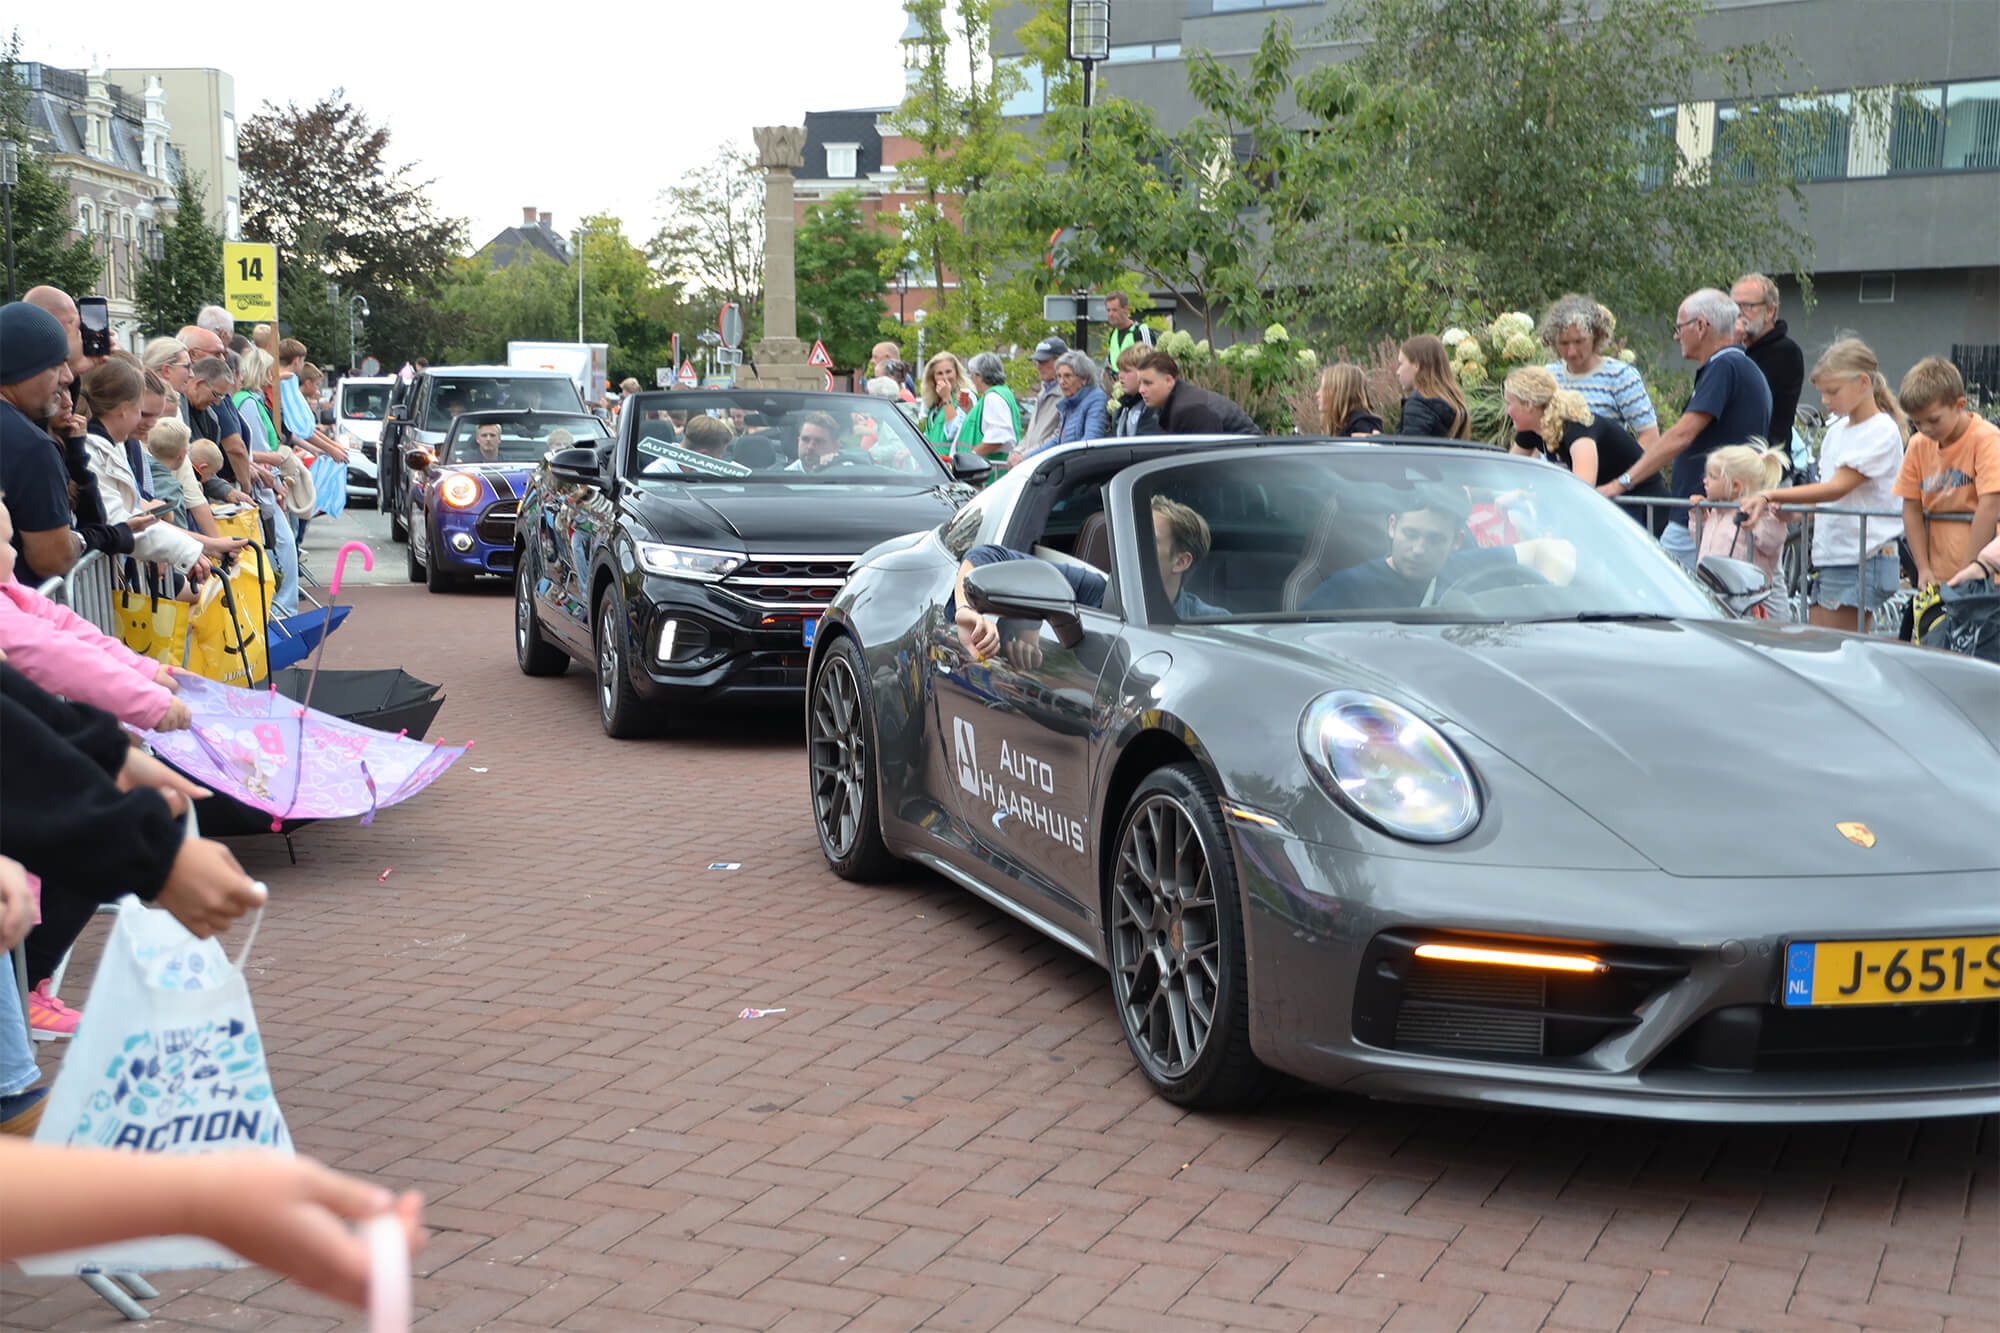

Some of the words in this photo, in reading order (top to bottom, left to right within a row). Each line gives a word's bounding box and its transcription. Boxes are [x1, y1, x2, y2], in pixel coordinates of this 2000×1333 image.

[237, 257, 263, 281] 14
[1000, 739, 1054, 794] AUTO
[980, 769, 1085, 853] HAARHUIS
[1789, 980, 1808, 994] NL
[113, 1109, 262, 1153] ACTION
